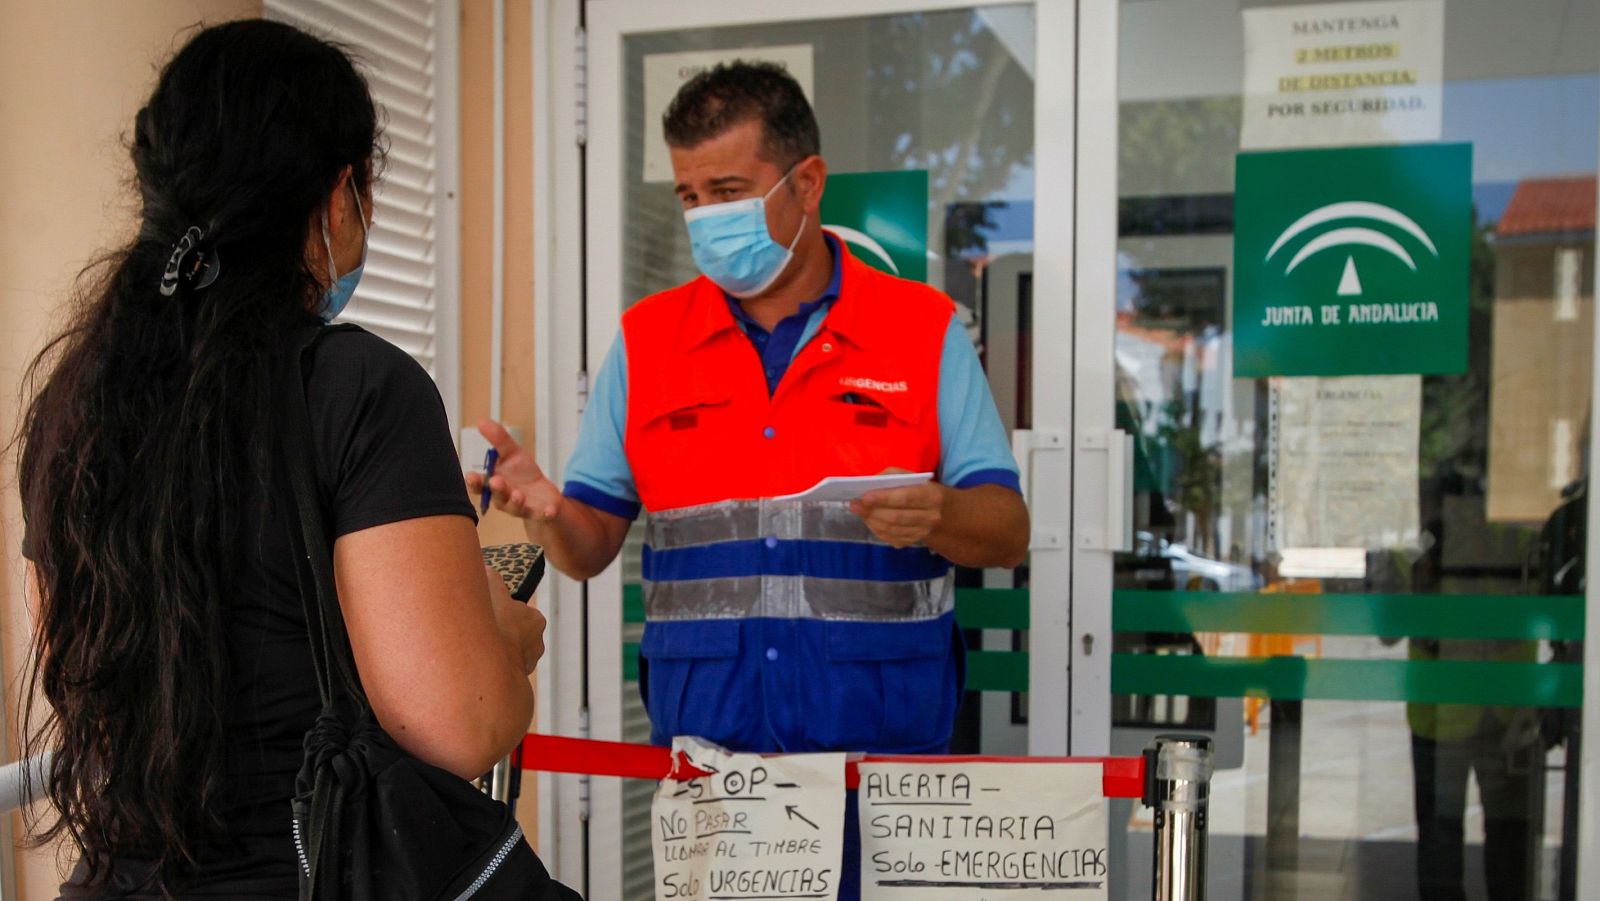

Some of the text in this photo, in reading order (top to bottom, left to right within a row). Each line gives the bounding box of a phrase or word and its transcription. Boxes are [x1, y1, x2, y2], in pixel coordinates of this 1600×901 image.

[1291, 16, 1400, 34] MANTENGA
[1296, 44, 1394, 64] 2 METROS
[1279, 77, 1301, 92] DE
[1268, 102, 1304, 117] POR
[1261, 302, 1439, 326] JUNTA DE ANDALUCIA
[838, 376, 908, 392] URGENCIAS
[867, 773, 971, 800] ALERTA
[660, 809, 748, 836] NO PASAR
[871, 814, 1055, 840] SANITARIA
[715, 840, 737, 858] AL
[749, 839, 822, 857] TIMBRE
[871, 850, 926, 874] Solo
[710, 867, 832, 894] URGENCIAS
